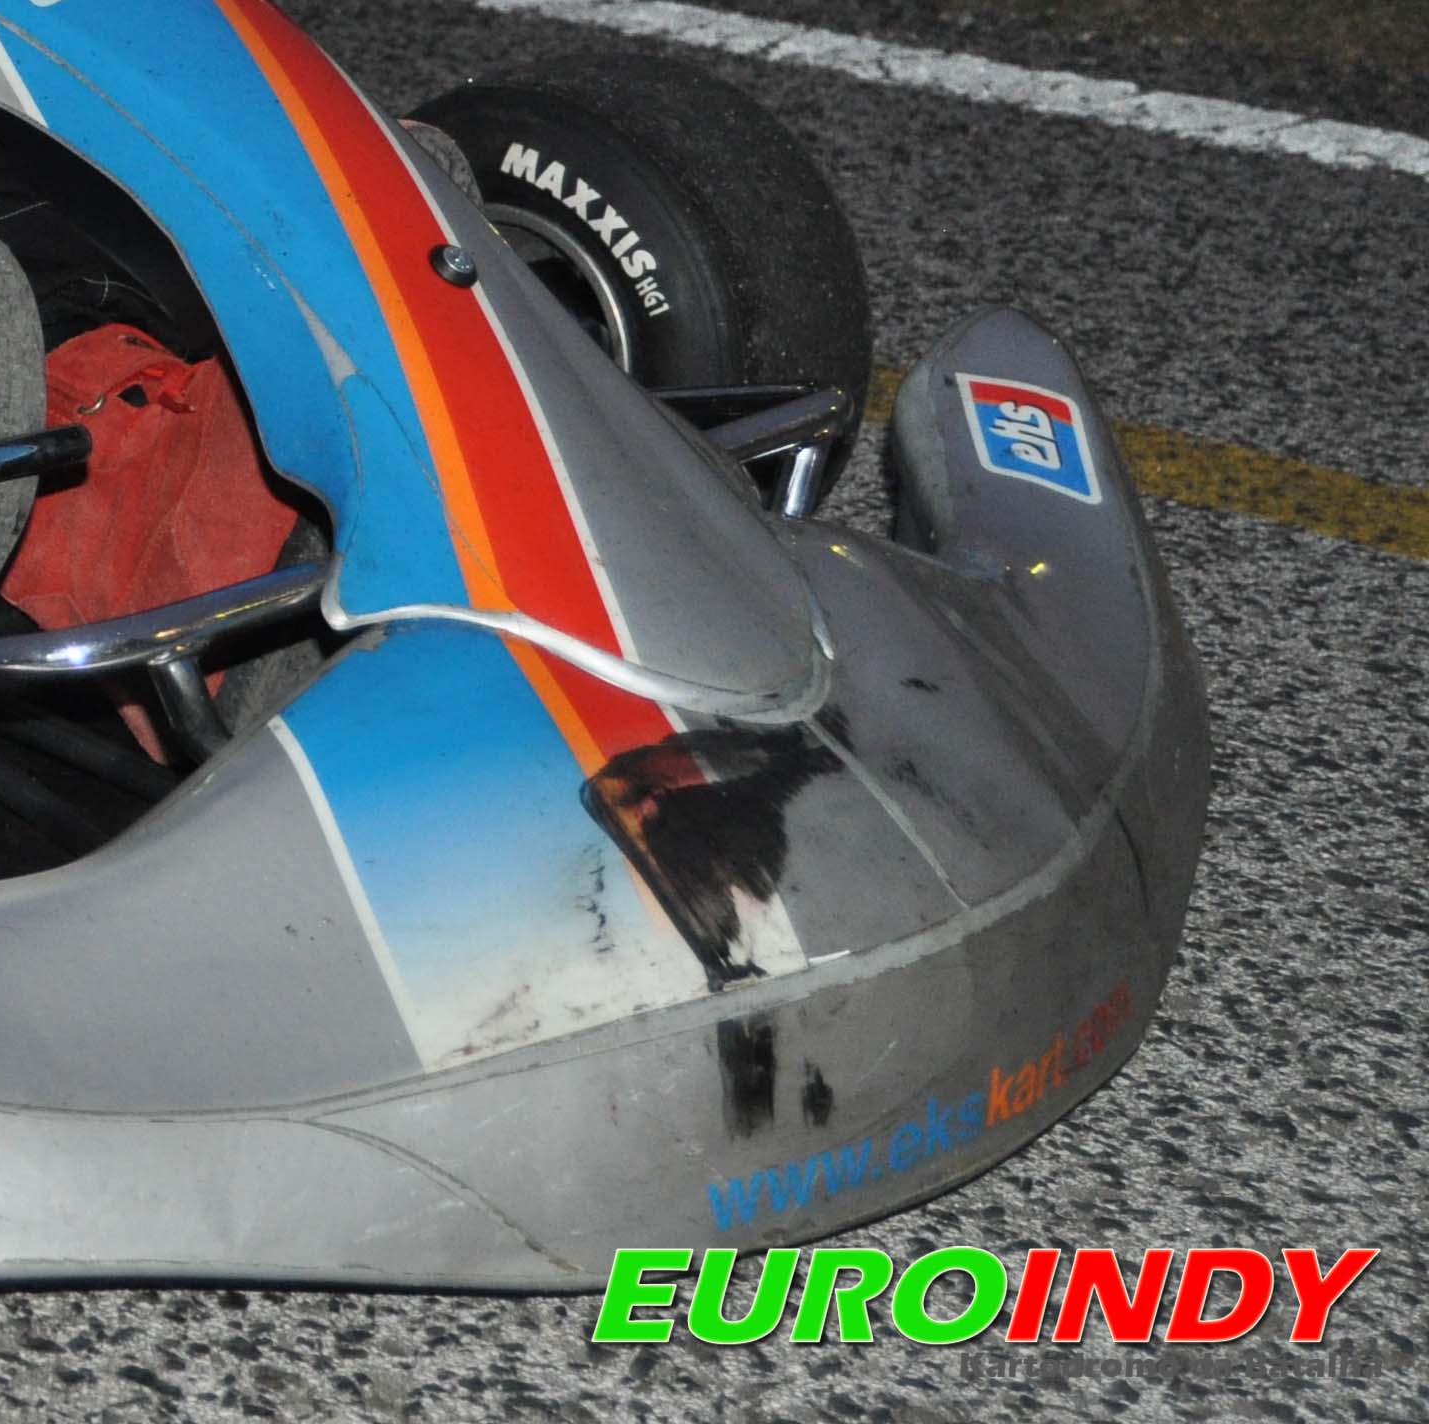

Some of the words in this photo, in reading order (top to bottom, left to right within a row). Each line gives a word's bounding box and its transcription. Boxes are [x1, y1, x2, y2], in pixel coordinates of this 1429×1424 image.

[500, 142, 657, 279] MAXXIS
[635, 276, 670, 317] HG1
[706, 980, 1137, 1232] www.ekskart.com
